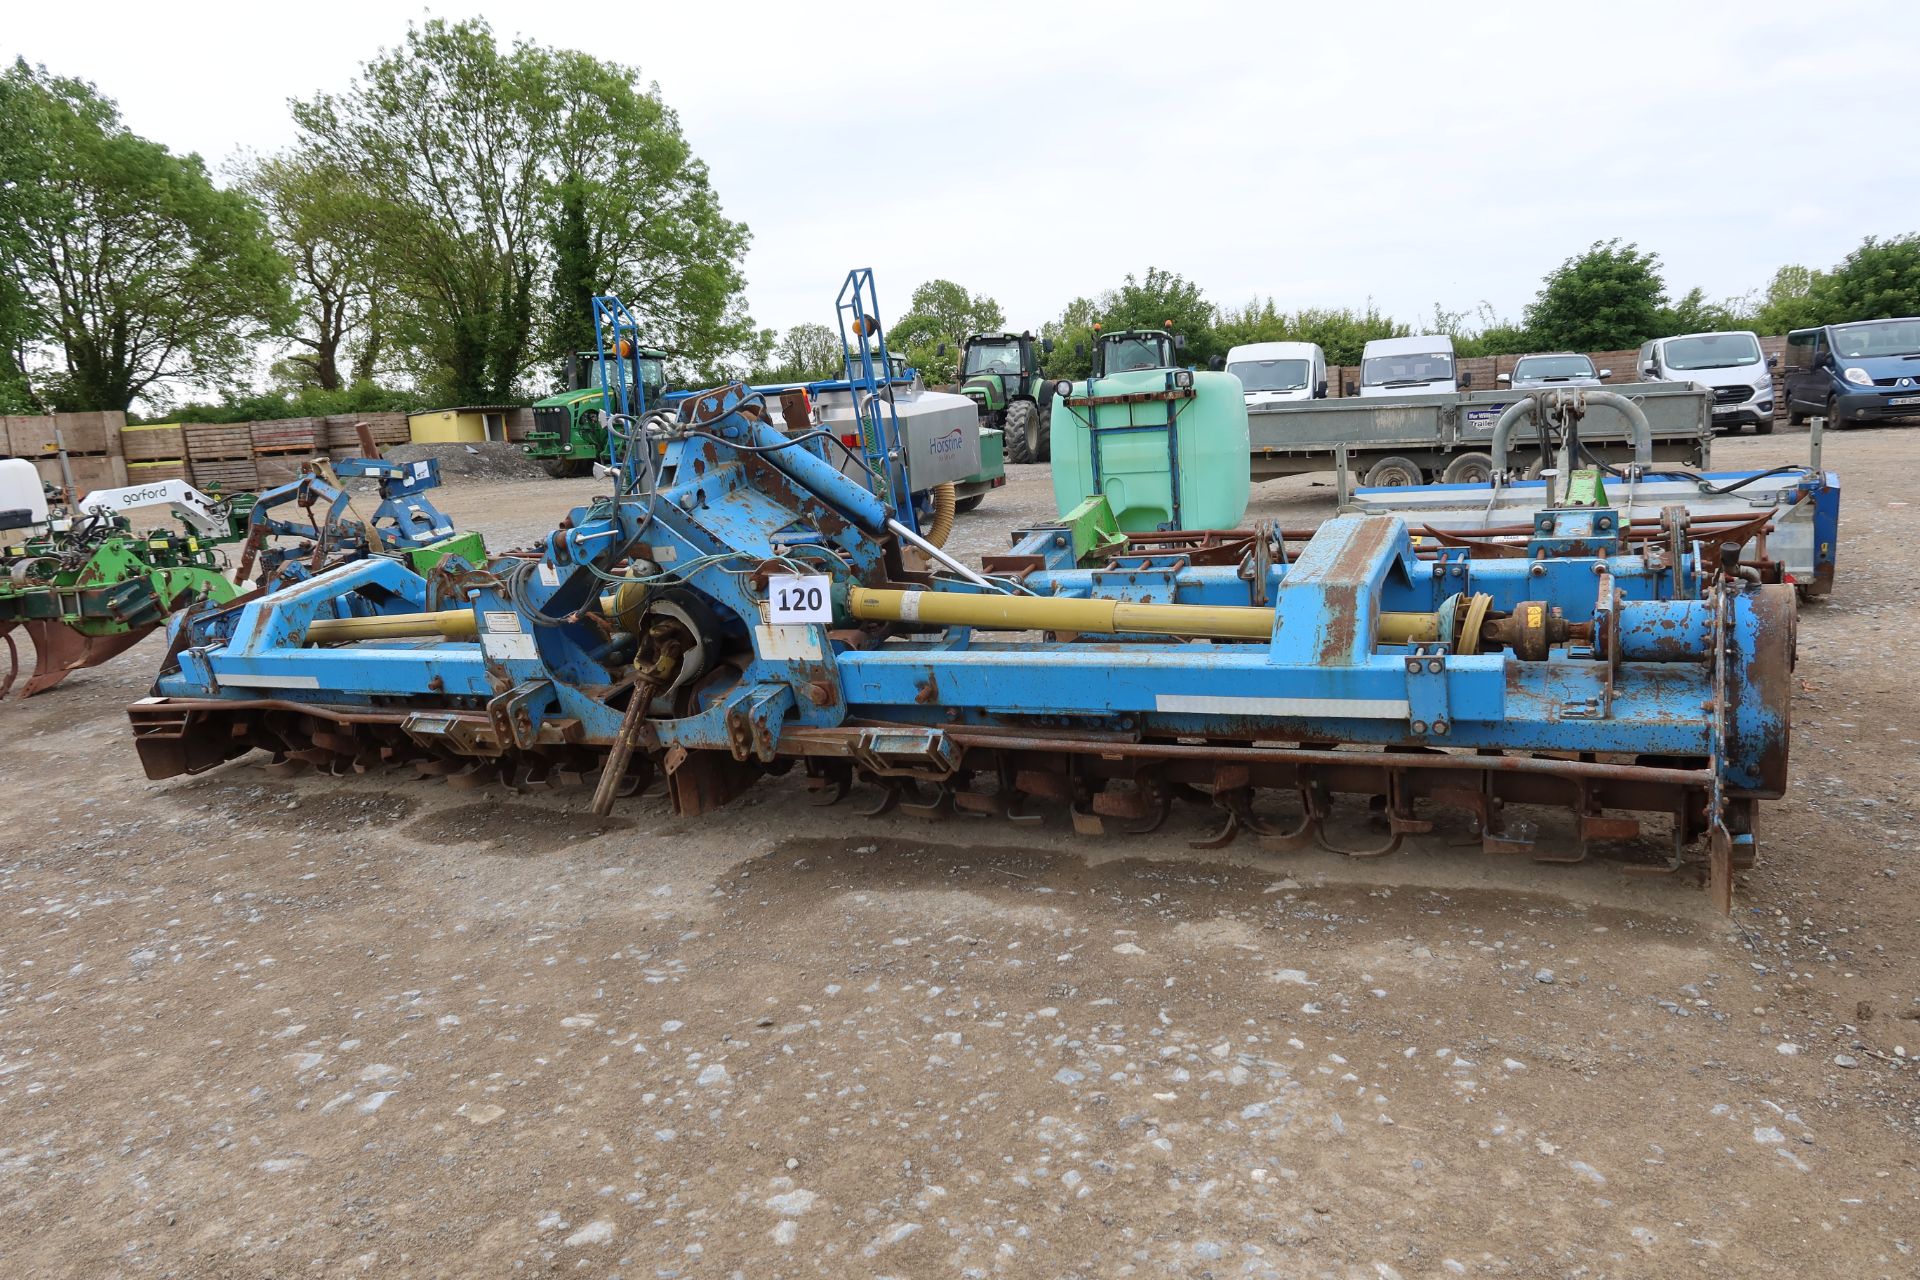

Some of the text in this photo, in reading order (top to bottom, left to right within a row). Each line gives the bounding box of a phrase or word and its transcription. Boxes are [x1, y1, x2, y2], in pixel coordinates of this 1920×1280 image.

[929, 435, 962, 455] Horstine
[123, 486, 167, 505] garford
[778, 587, 823, 611] 120
